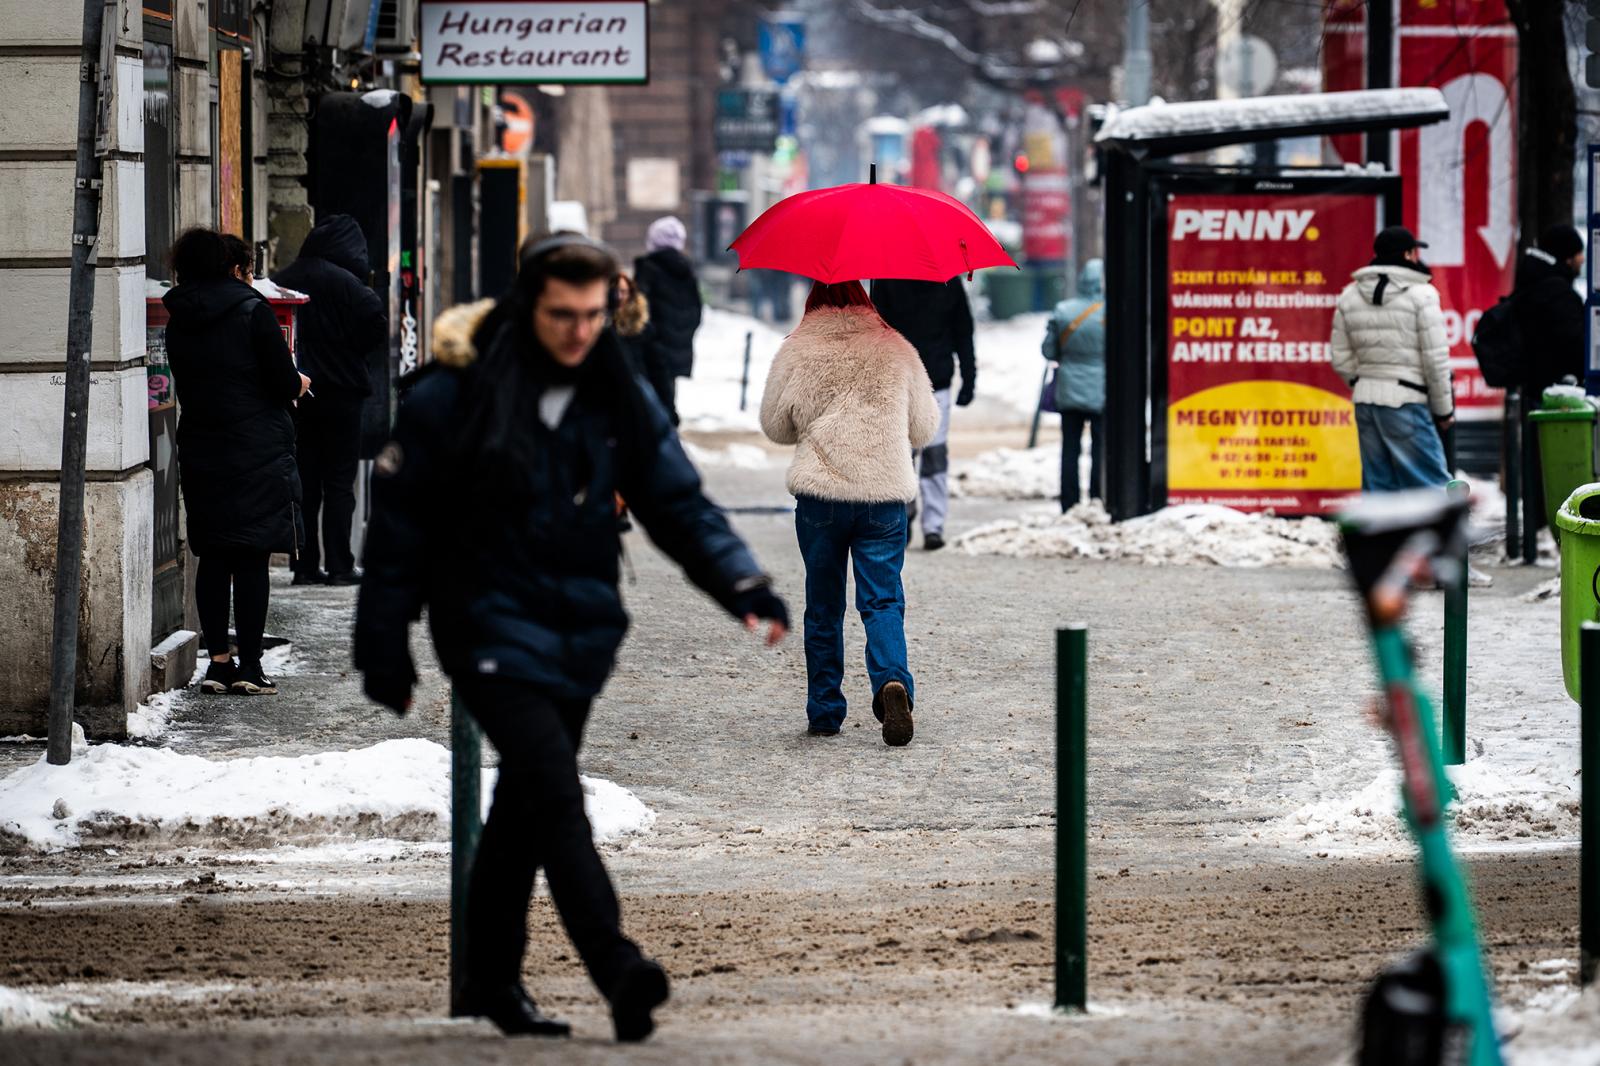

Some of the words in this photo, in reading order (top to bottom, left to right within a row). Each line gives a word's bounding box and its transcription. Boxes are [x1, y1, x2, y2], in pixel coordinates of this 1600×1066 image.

[438, 11, 626, 40] Hungarian
[436, 43, 630, 67] Restaurant
[1172, 270, 1214, 285] SZENT
[1217, 267, 1267, 285] ISTVÁN
[1270, 270, 1301, 285] KRT.
[1172, 290, 1233, 308] VÁRUNK
[1172, 317, 1236, 337] PONT
[1240, 317, 1279, 340] AZ,
[1172, 342, 1233, 363] AMIT
[1176, 410, 1352, 426] MEGNYITOTTUNK
